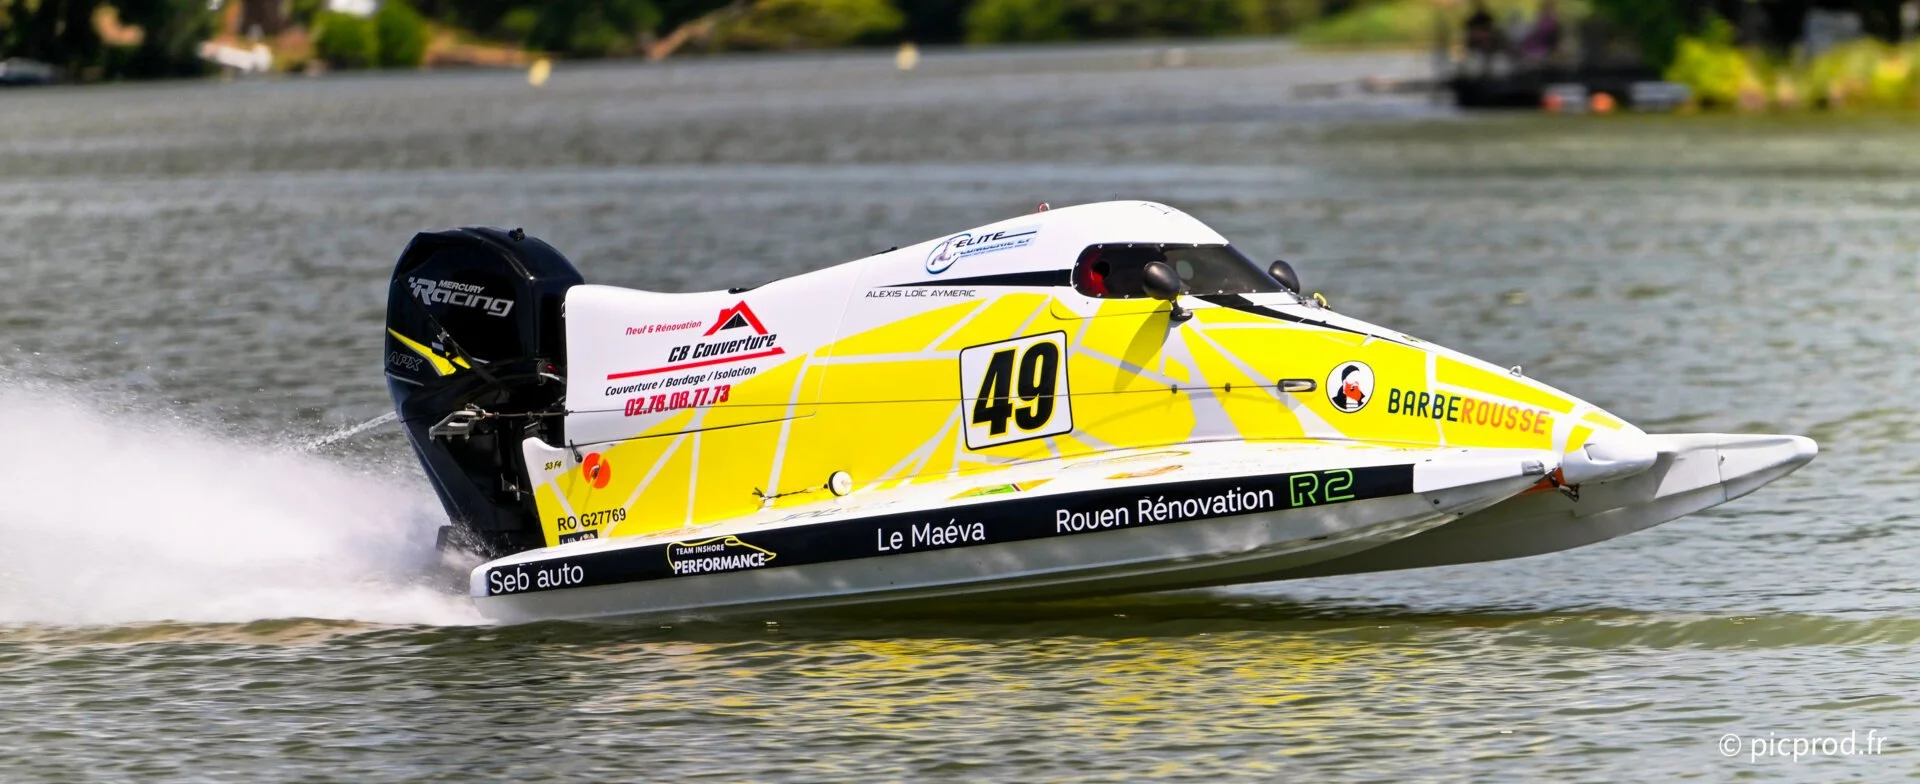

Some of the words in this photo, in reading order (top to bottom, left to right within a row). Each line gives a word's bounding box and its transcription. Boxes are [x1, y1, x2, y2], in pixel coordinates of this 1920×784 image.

[954, 231, 1006, 248] ELITE
[408, 276, 515, 318] Racing
[438, 279, 485, 294] MERCURY
[865, 289, 902, 298] ALEXIS
[904, 287, 928, 298] LOÏC
[930, 289, 976, 298] AYMERIC
[625, 325, 648, 336] Neuf
[647, 324, 655, 334] &
[655, 320, 702, 333] Rénovation
[387, 351, 423, 372] APX
[667, 345, 691, 363] CB
[692, 333, 777, 360] Couverture
[605, 380, 658, 397] Couverture
[665, 374, 706, 388] Bardage
[713, 365, 757, 381] Isolation
[972, 342, 1059, 436] 49
[624, 384, 731, 417] 02.76.08.77.73
[1387, 387, 1551, 435] BARBEROUSSE
[1290, 468, 1355, 507] R2
[557, 515, 577, 532] RO
[580, 507, 627, 528] G27769
[1056, 505, 1129, 534] Rouen
[1137, 486, 1275, 523] Rénovation
[676, 545, 695, 555] TEAM
[695, 543, 725, 554] INSHORE
[877, 527, 904, 551] Le
[911, 518, 986, 548] Maéva
[489, 564, 530, 595] Seb
[537, 563, 584, 588] auto
[674, 552, 766, 575] PERFORMANCE
